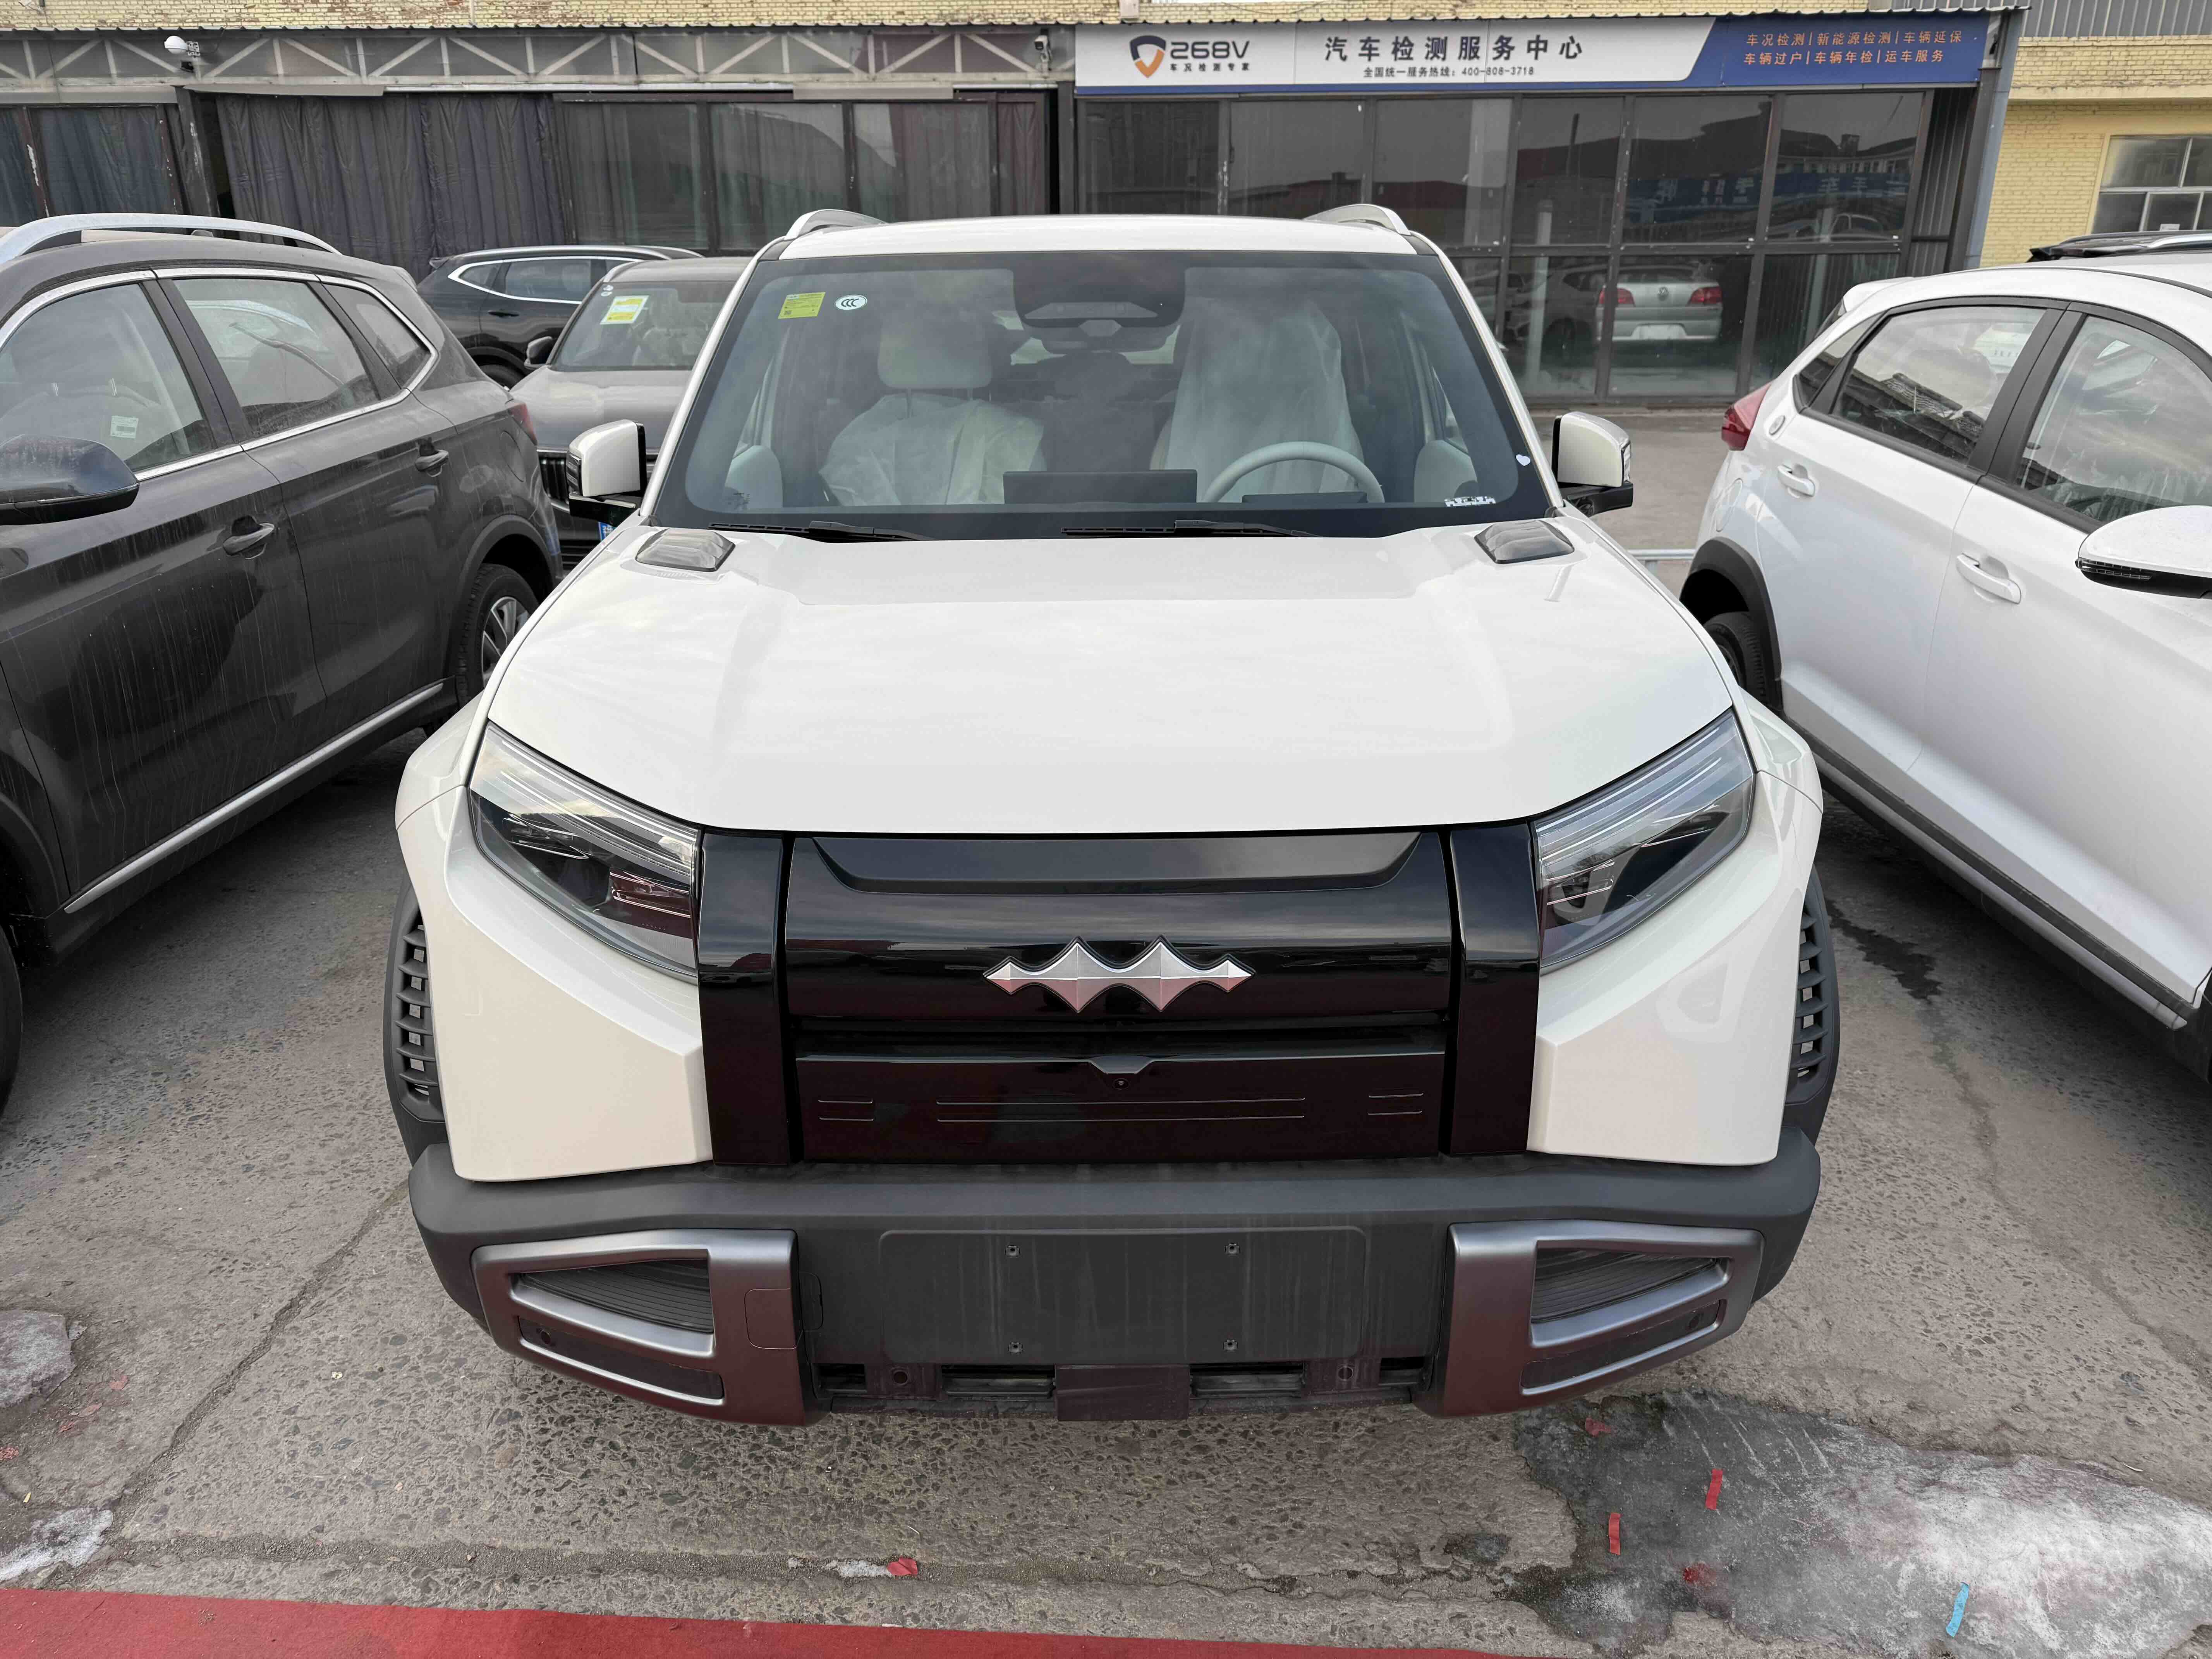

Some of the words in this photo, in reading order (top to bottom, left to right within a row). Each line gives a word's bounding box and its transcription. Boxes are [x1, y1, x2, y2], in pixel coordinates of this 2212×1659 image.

[1170, 41, 1250, 60] 268V
[1324, 34, 1583, 61] 汽车检测服务中心
[1170, 63, 1250, 72] 车况检测专家
